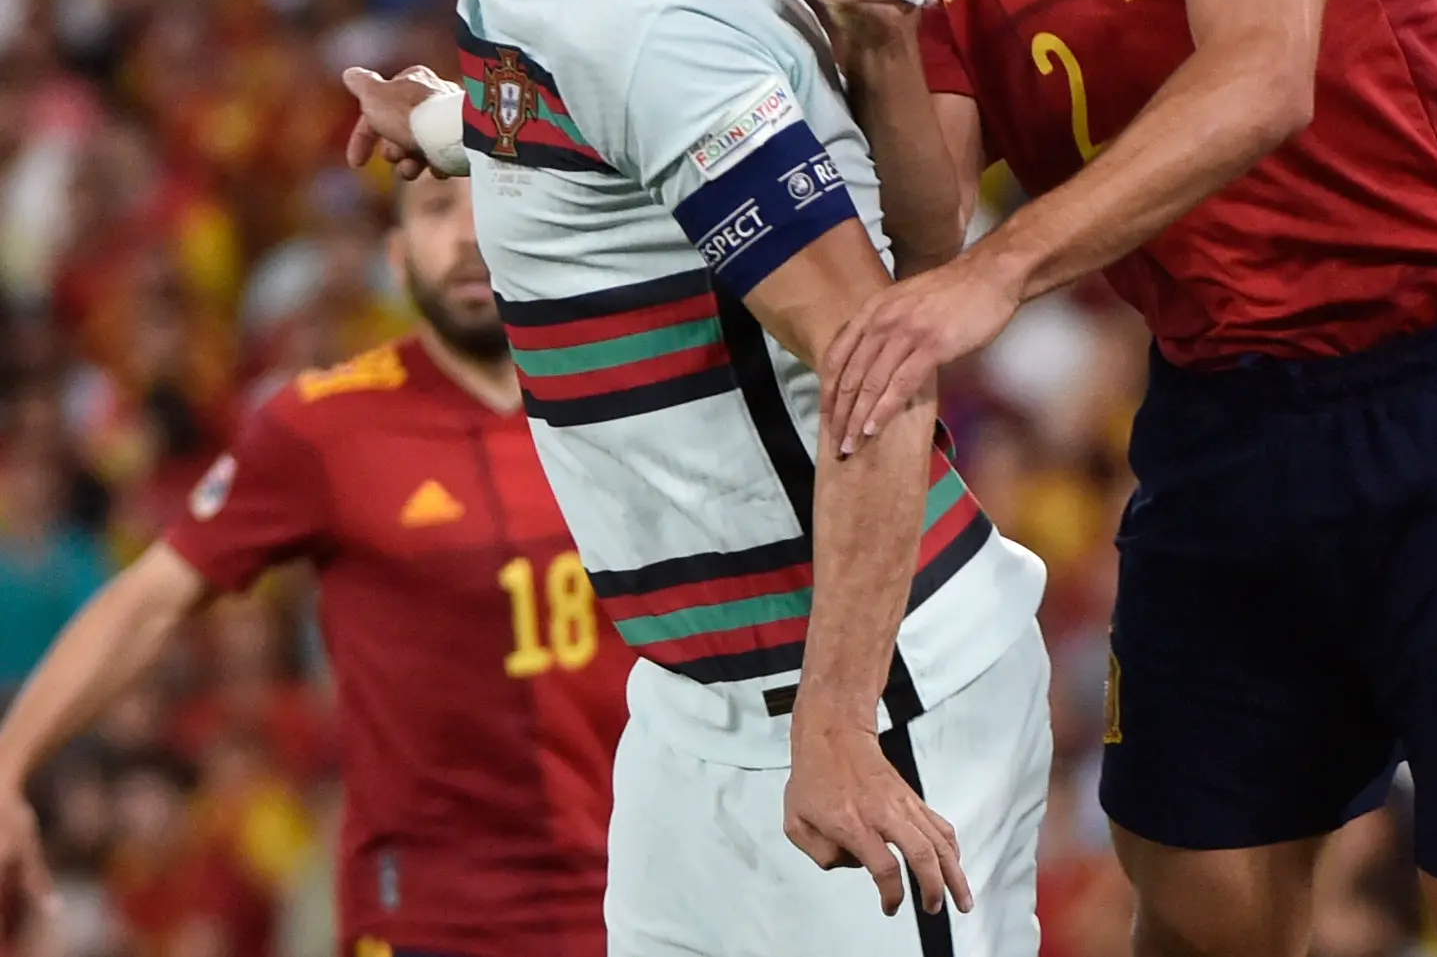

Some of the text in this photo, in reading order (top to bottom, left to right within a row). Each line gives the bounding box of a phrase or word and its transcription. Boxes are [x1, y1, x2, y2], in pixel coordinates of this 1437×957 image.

[695, 88, 787, 167] FOUNDATION
[1032, 32, 1112, 165] 2
[499, 551, 598, 678] 18
